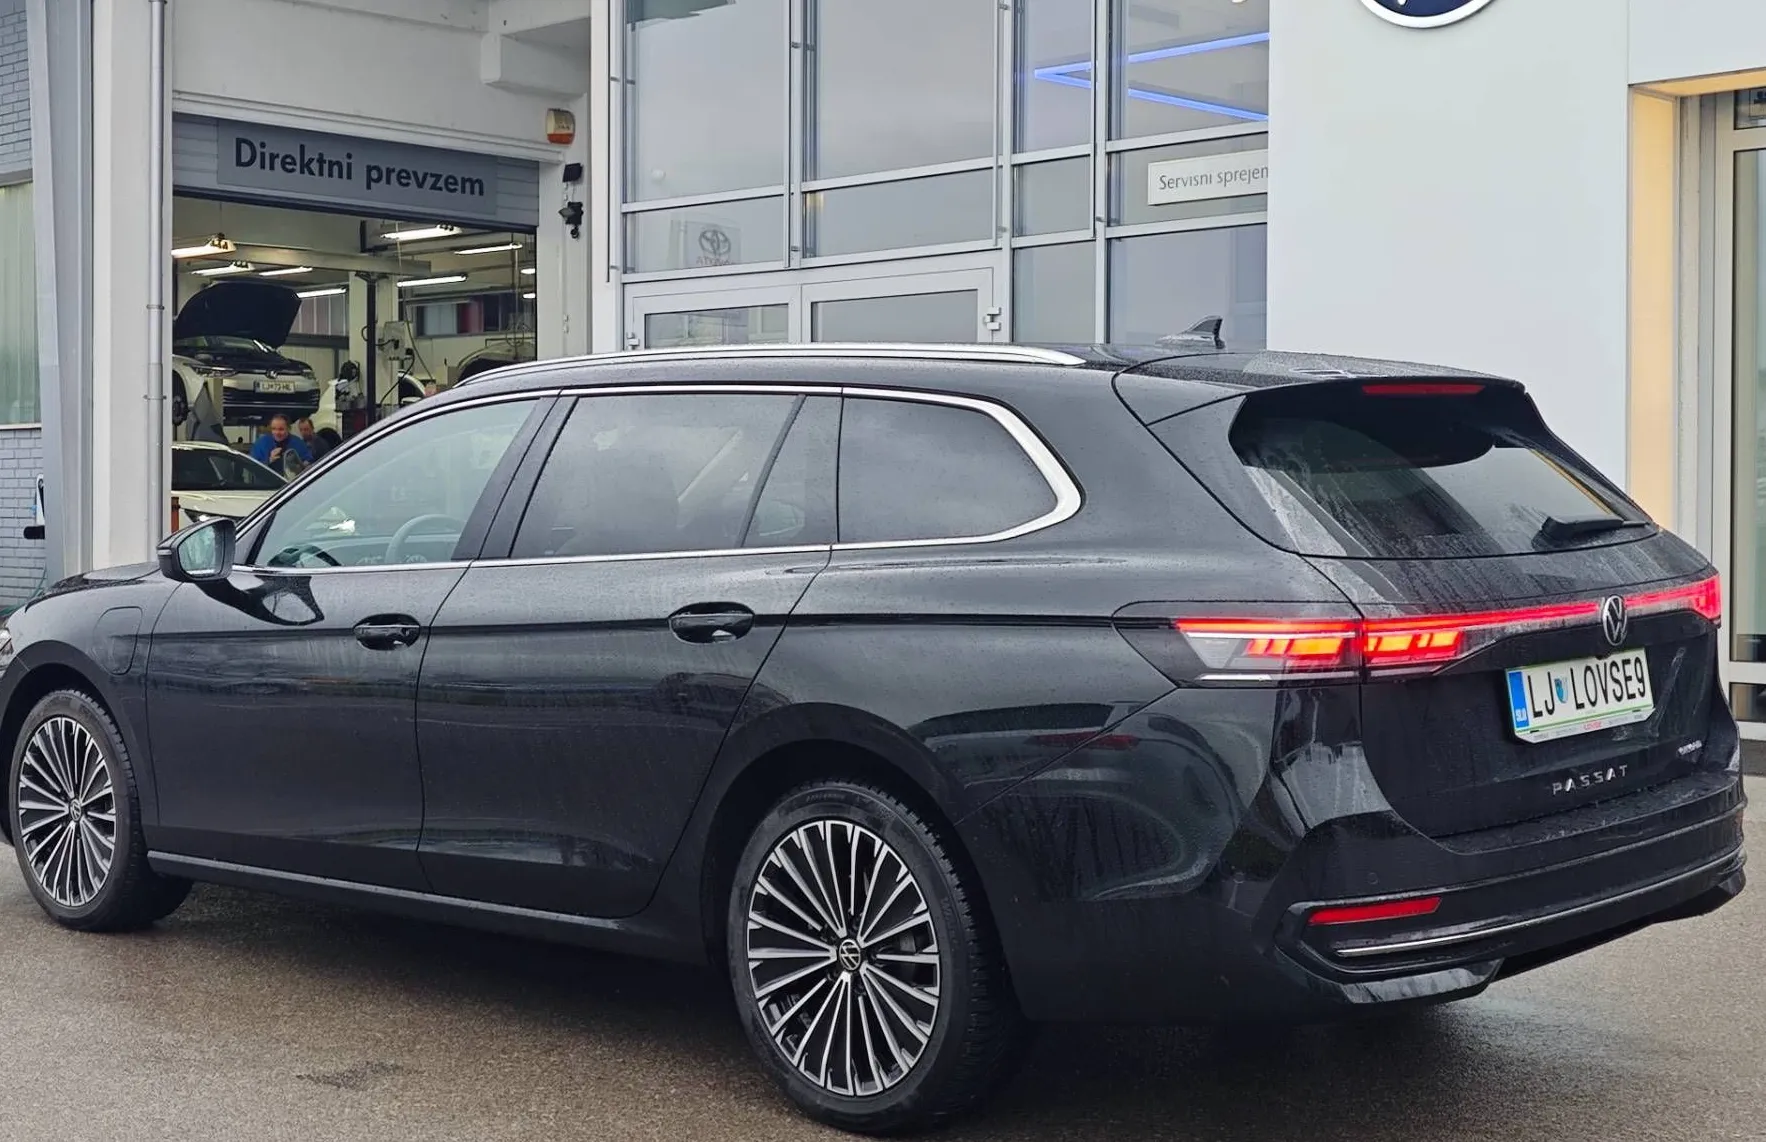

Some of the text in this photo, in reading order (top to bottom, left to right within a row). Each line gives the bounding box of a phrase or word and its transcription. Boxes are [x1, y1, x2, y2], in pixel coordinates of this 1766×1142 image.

[235, 137, 485, 196] Direktni prevzem
[1159, 173, 1213, 190] Servisni
[1527, 657, 1646, 718] LJ LOVSE9
[1551, 764, 1628, 795] PASSAT
